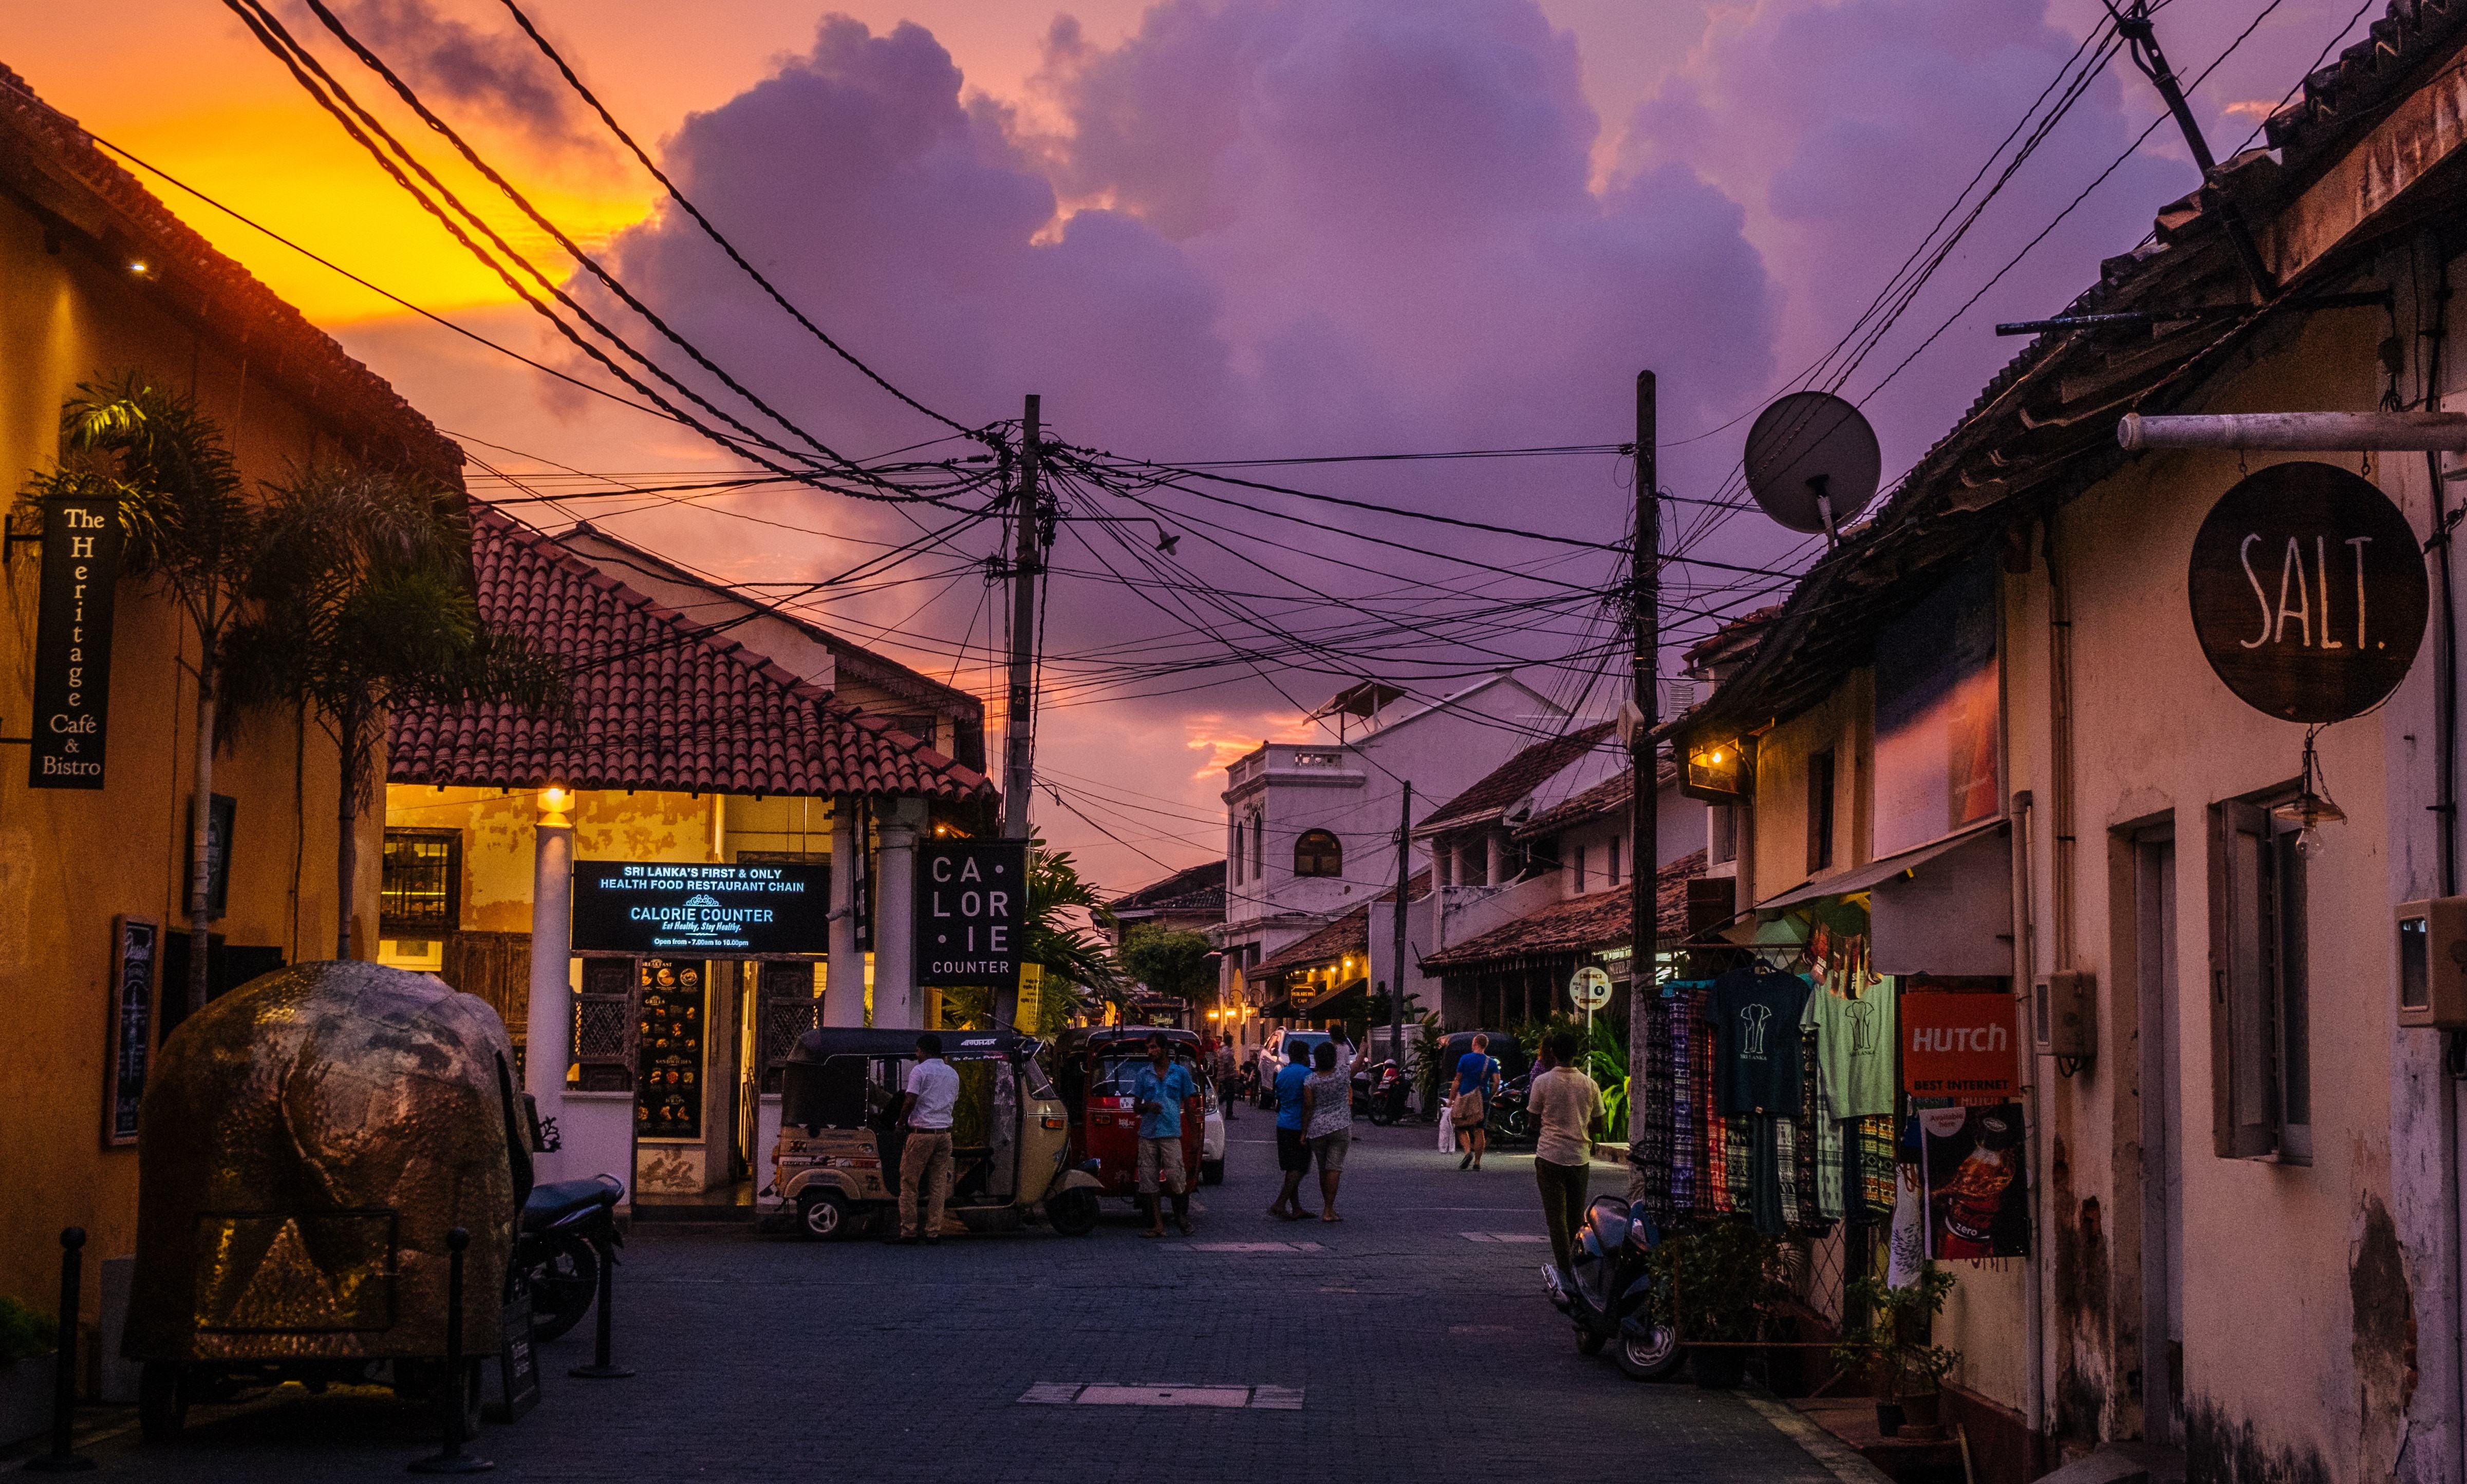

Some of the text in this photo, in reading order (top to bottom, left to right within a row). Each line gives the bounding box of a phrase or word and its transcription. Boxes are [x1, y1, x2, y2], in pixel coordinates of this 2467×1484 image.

[64, 509, 105, 529] The
[69, 537, 94, 707] Heritage
[50, 713, 97, 734] Café
[65, 739, 80, 754] &
[43, 756, 101, 776] Bistro
[624, 867, 782, 879] SRI LANKA'S FIRST & ONLY
[600, 879, 805, 892] HEALTH FOOD RESTAURANT CHAIN
[630, 907, 773, 923] CALORIE COUNTER
[662, 922, 742, 932] Eat Healthy, Stay Healthy.
[723, 939, 749, 947] 10.00pm
[933, 961, 1009, 973] COUNTER
[1914, 1079, 2008, 1090] BEST INTERNET
[1955, 1222, 1978, 1236] zero
